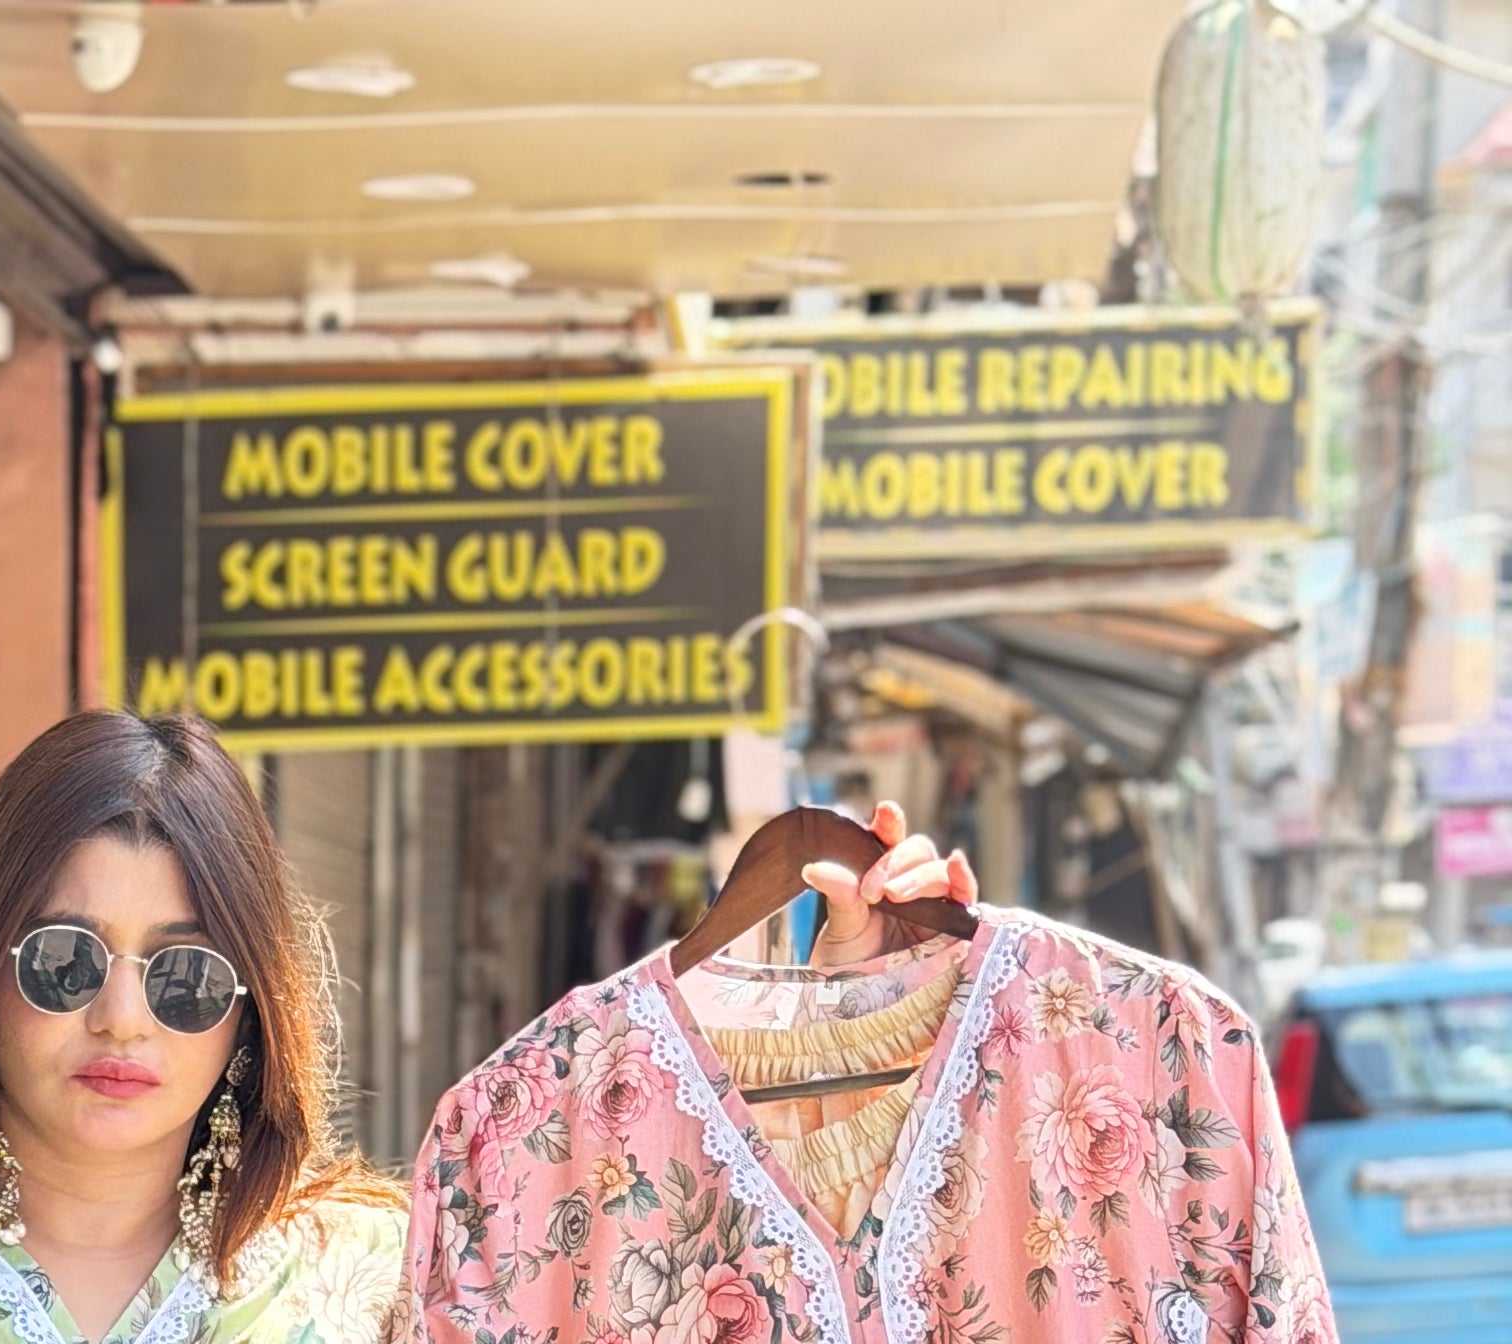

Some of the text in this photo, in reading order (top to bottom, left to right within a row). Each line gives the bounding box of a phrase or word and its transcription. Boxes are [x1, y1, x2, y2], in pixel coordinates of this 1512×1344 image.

[821, 338, 1294, 420] OBILE REPAIRING
[222, 414, 666, 501] MOBILE COVER
[819, 441, 1229, 521] MOBILE COVER
[219, 527, 666, 612] SCREEN GUARD
[138, 632, 755, 723] MOBILE ACCESSORIES
